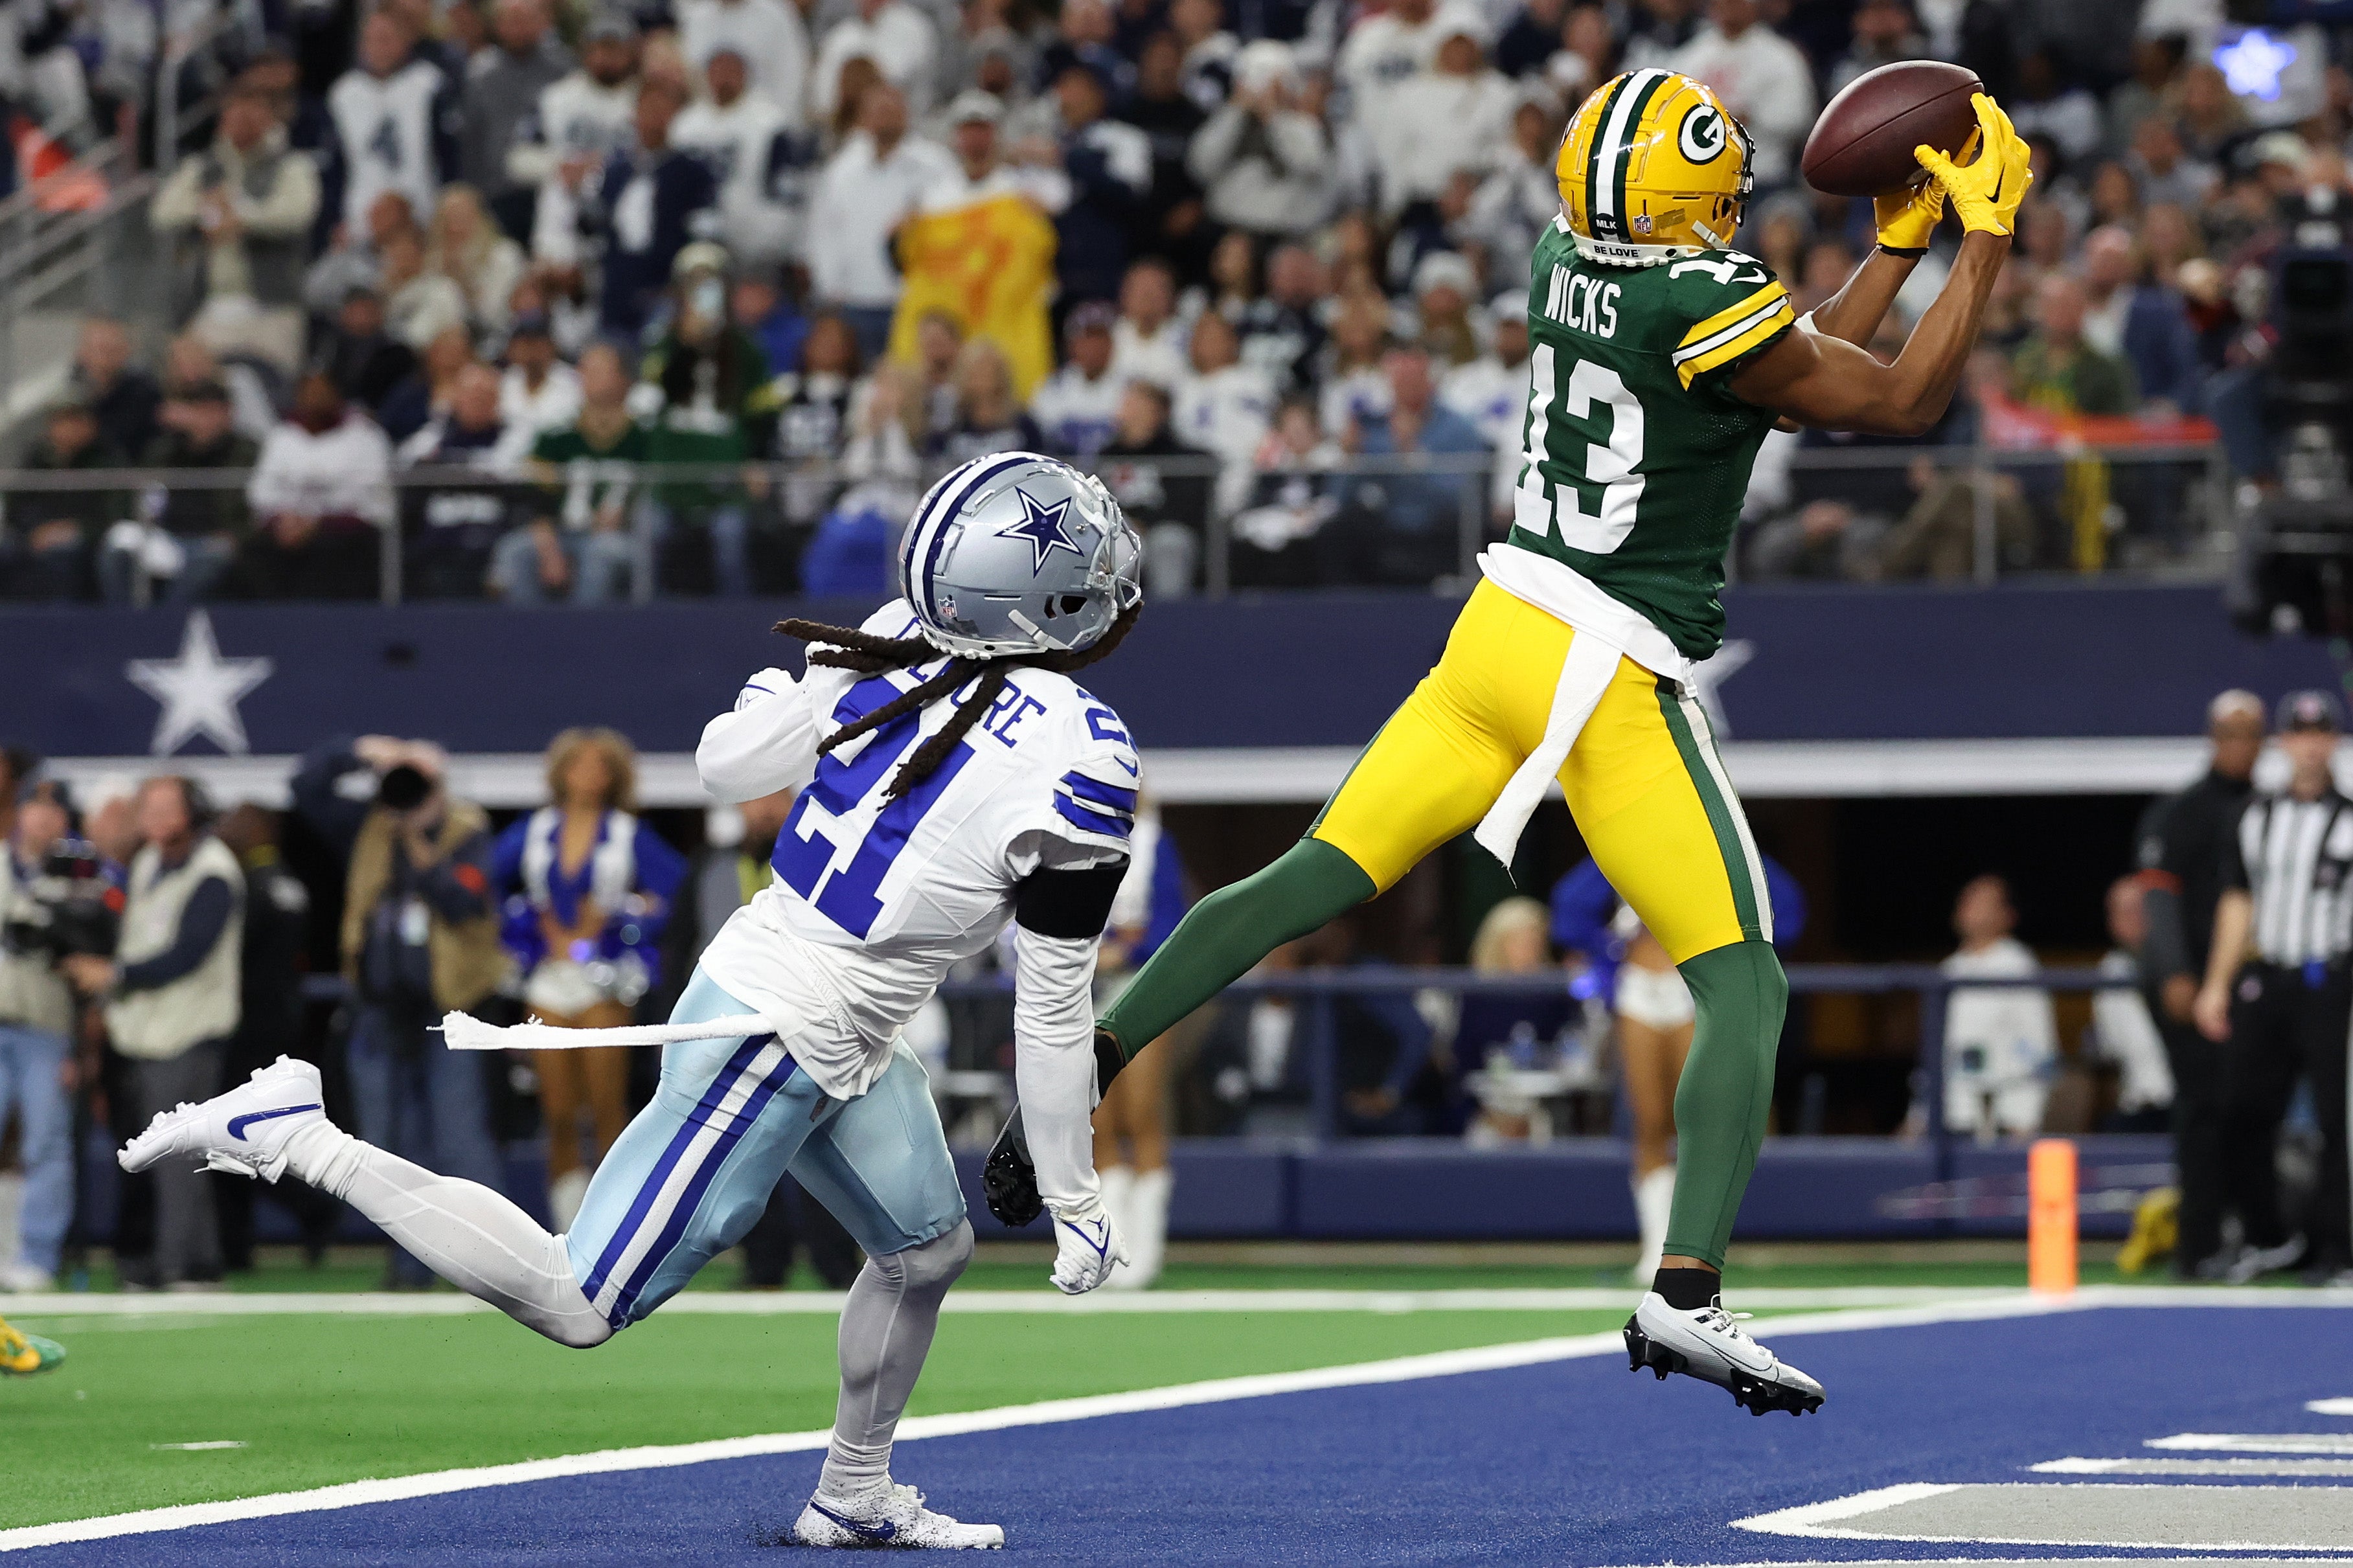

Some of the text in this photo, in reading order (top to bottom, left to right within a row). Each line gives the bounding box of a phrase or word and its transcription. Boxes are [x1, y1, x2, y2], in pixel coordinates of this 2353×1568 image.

[1678, 103, 1726, 165] G
[1593, 245, 1640, 258] BE LOVE
[1595, 218, 1617, 230] MLK
[1544, 263, 1621, 339] WICKS
[1514, 342, 1648, 554] 13
[769, 674, 976, 941] 21
